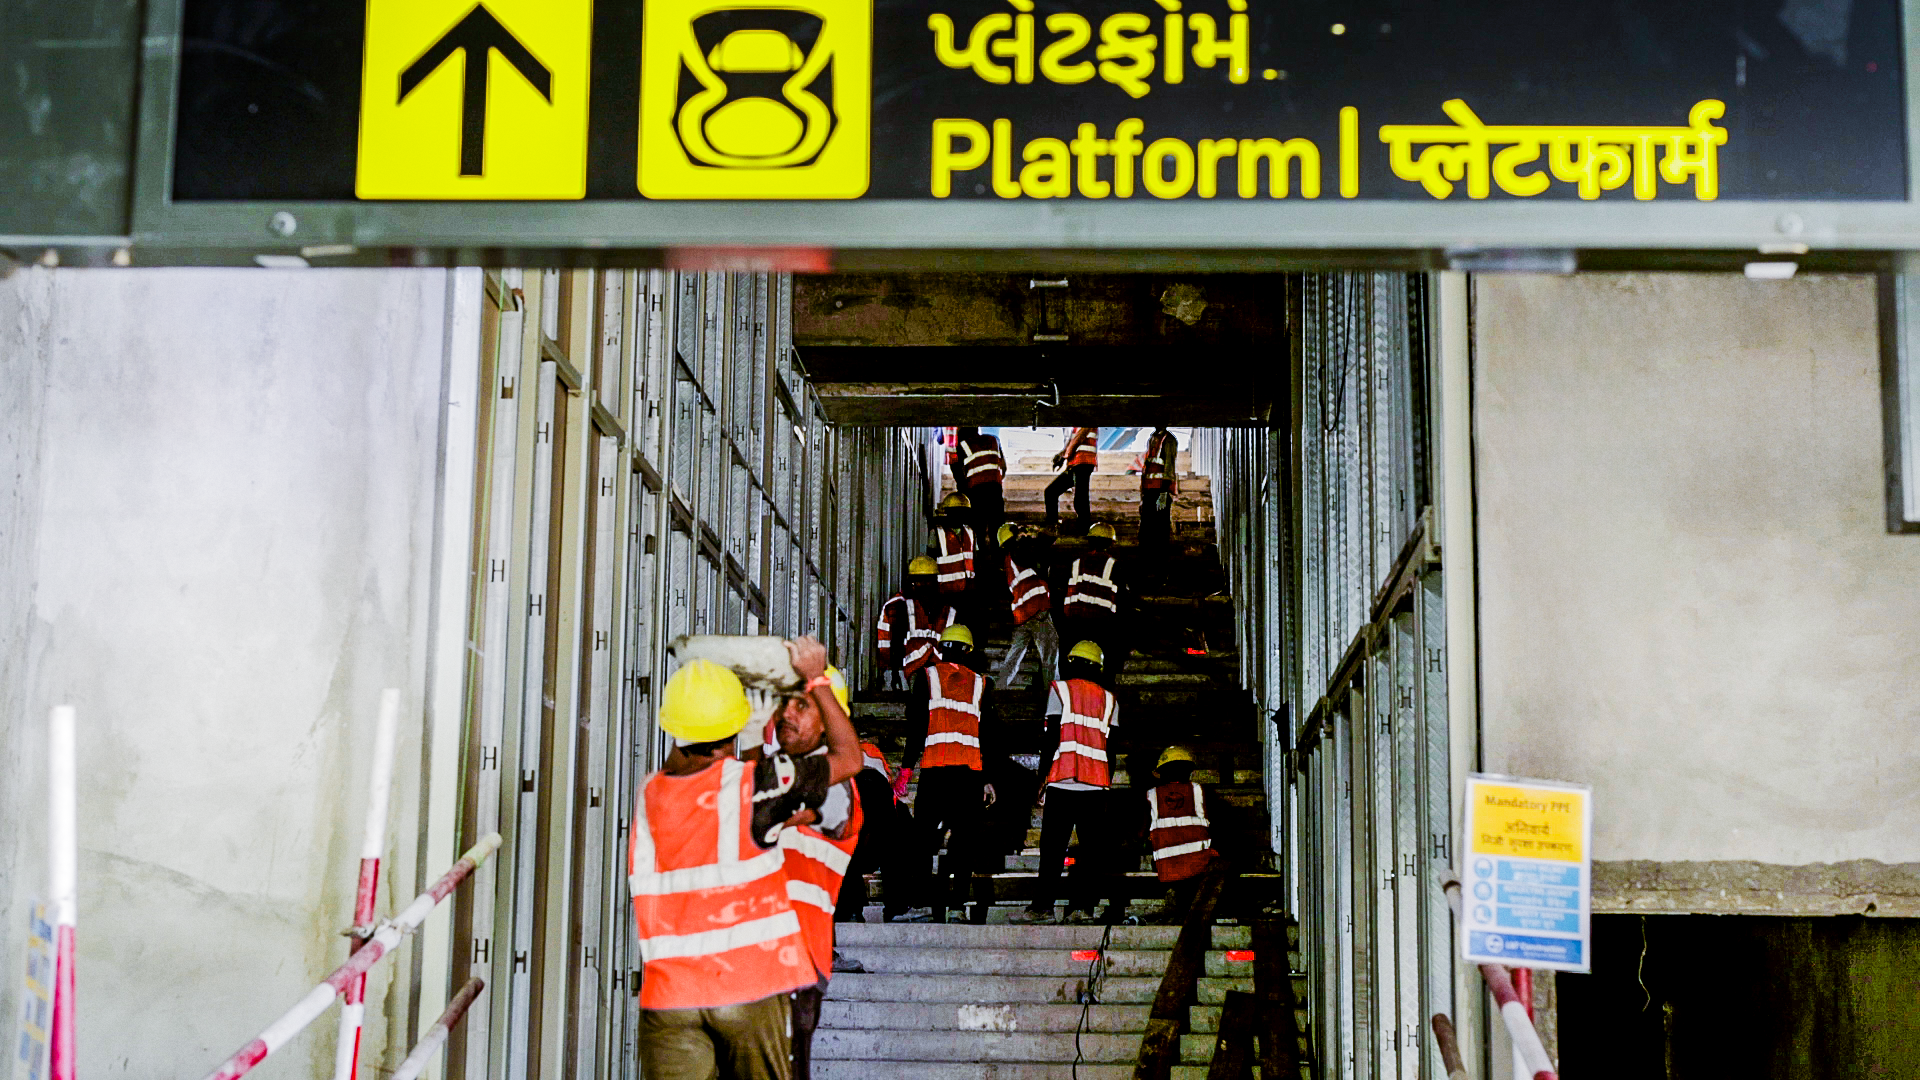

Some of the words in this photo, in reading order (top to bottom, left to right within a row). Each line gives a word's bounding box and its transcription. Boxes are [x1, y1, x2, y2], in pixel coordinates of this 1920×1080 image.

[930, 117, 1322, 200] Platform
[1378, 98, 1729, 201] प्लेटफार्म
[1485, 795, 1548, 814] Mandatory
